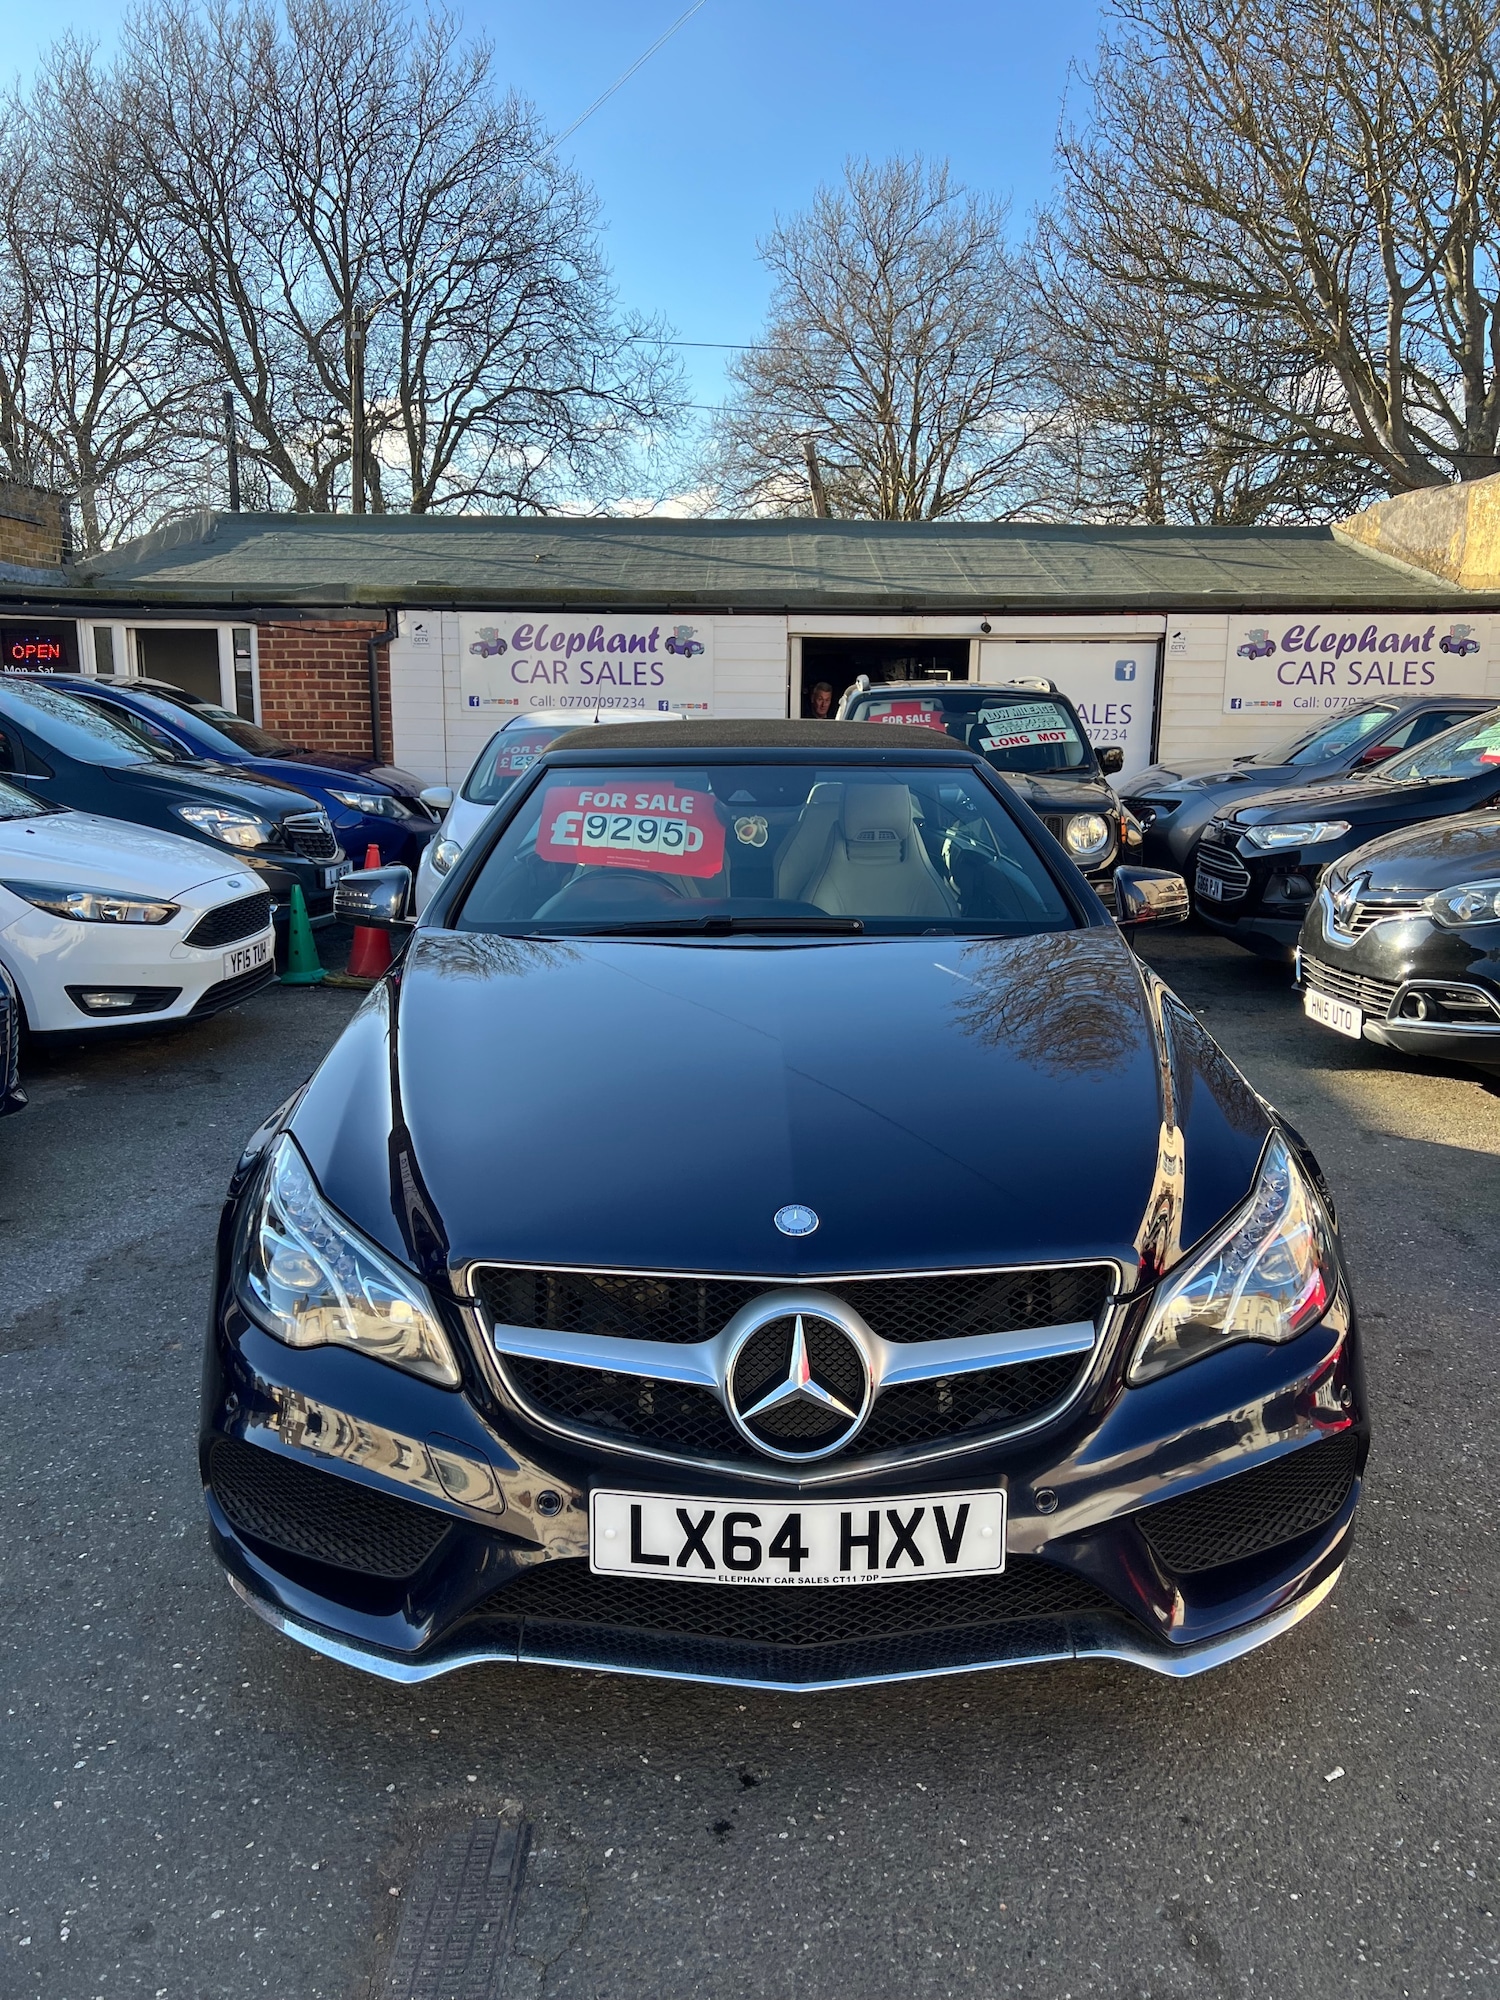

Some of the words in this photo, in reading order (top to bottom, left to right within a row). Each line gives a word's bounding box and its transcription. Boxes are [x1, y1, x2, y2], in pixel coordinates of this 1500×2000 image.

[12, 645, 60, 658] OPEN
[511, 624, 660, 659] Elephant
[1281, 625, 1436, 660] Elephant
[511, 660, 569, 684] CAR
[580, 661, 664, 686] SALES
[1277, 661, 1336, 685] CAR
[1347, 661, 1436, 685] SALES
[530, 696, 555, 707] Call:
[560, 697, 645, 708] 07707097234
[1293, 697, 1319, 708] Call:
[882, 716, 903, 724] FOR
[905, 714, 931, 724] SALE
[986, 709, 1009, 721] LOW
[1011, 705, 1056, 717] MILEAGE
[1077, 704, 1132, 724] ALES
[502, 745, 530, 754] FOR
[990, 735, 1030, 748] LONG
[1037, 732, 1066, 742] MOT
[578, 791, 627, 808] FOR
[634, 793, 694, 814] SALE
[231, 949, 250, 973] YF15
[1312, 995, 1329, 1020] HN15
[1333, 1005, 1352, 1030] UTO
[631, 1504, 809, 1572] LX64
[840, 1503, 971, 1571] HXV
[718, 1575, 771, 1584] ELEPHANT
[774, 1576, 795, 1584] CAR
[800, 1575, 830, 1584] SALES
